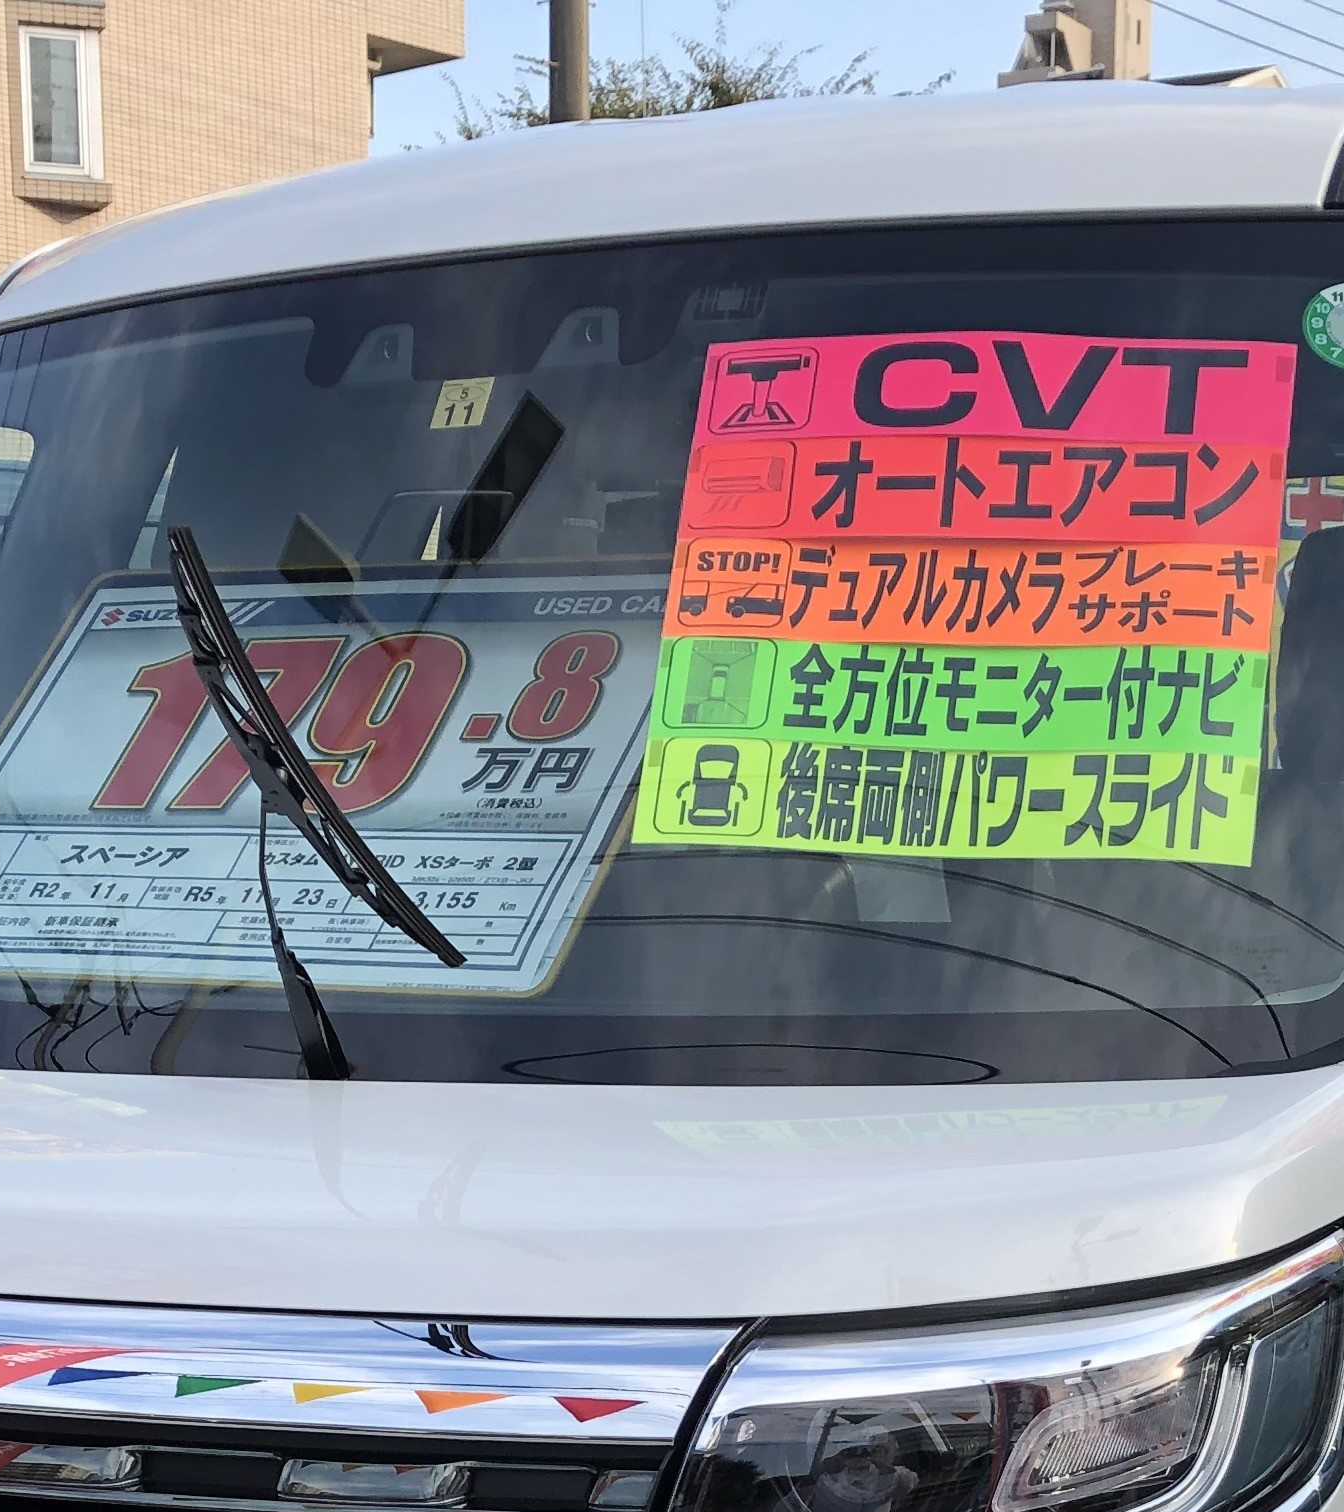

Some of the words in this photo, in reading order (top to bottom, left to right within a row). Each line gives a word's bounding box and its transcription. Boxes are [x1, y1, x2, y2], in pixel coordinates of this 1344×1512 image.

[1315, 302, 1331, 314] 10
[1331, 290, 1344, 303] 11
[1310, 316, 1324, 329] 9
[1314, 333, 1328, 346] 8
[1330, 346, 1343, 358] 7
[459, 387, 470, 400] 5
[855, 340, 1248, 435] CVT
[444, 401, 475, 427] 11
[812, 437, 1259, 528] オートエアコン
[697, 549, 782, 574] STOP!
[1073, 547, 1261, 590] ブレーキ
[788, 545, 1063, 635] デュアルカメラ
[533, 596, 613, 616] USED
[620, 594, 666, 614] CA
[1067, 591, 1256, 635] サポート
[783, 643, 1248, 740] 全方位モニター付ナビ
[458, 745, 595, 795] 万円
[777, 742, 1234, 849] 後席両側パワースライド
[60, 844, 190, 868] スペーシア
